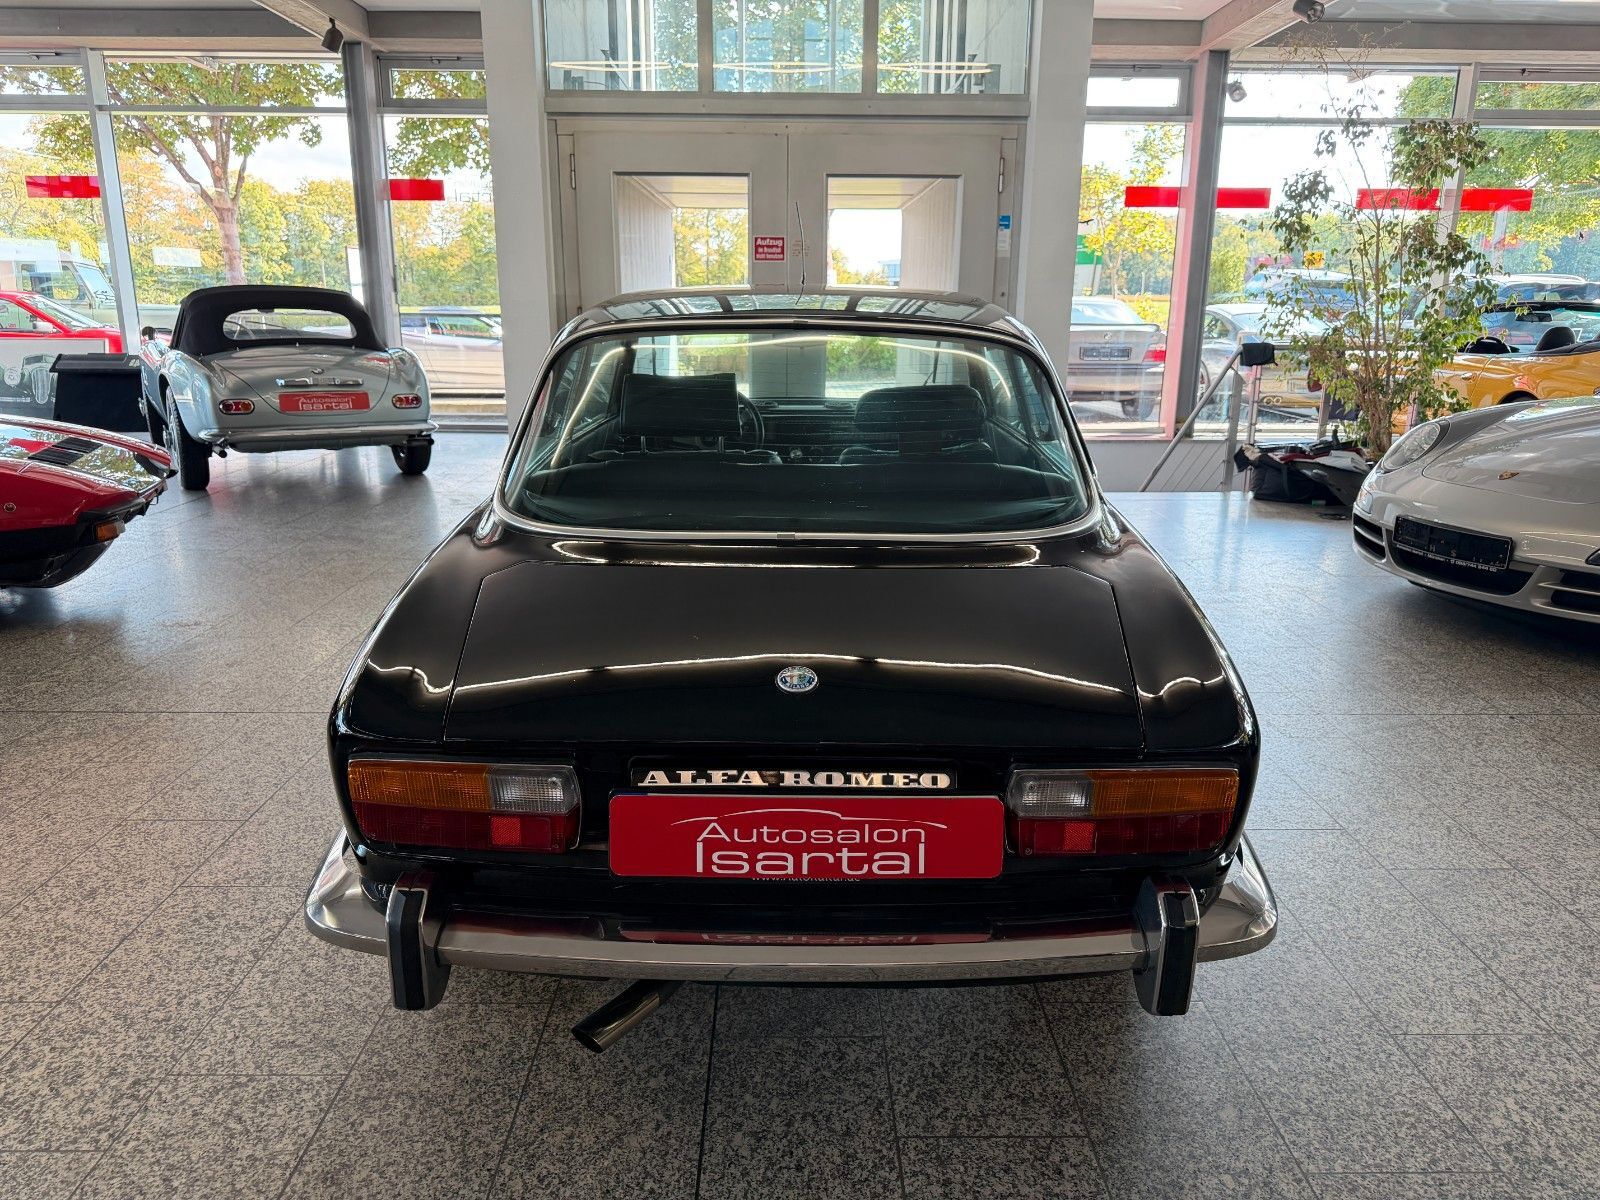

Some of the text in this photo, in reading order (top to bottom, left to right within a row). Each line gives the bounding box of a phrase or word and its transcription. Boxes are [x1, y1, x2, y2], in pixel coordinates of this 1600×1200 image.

[756, 238, 783, 246] Aufzug
[299, 400, 353, 410] Isartal
[637, 770, 951, 789] ALFA ROMEO
[696, 822, 926, 844] Autosalon
[696, 841, 926, 875] Isartal
